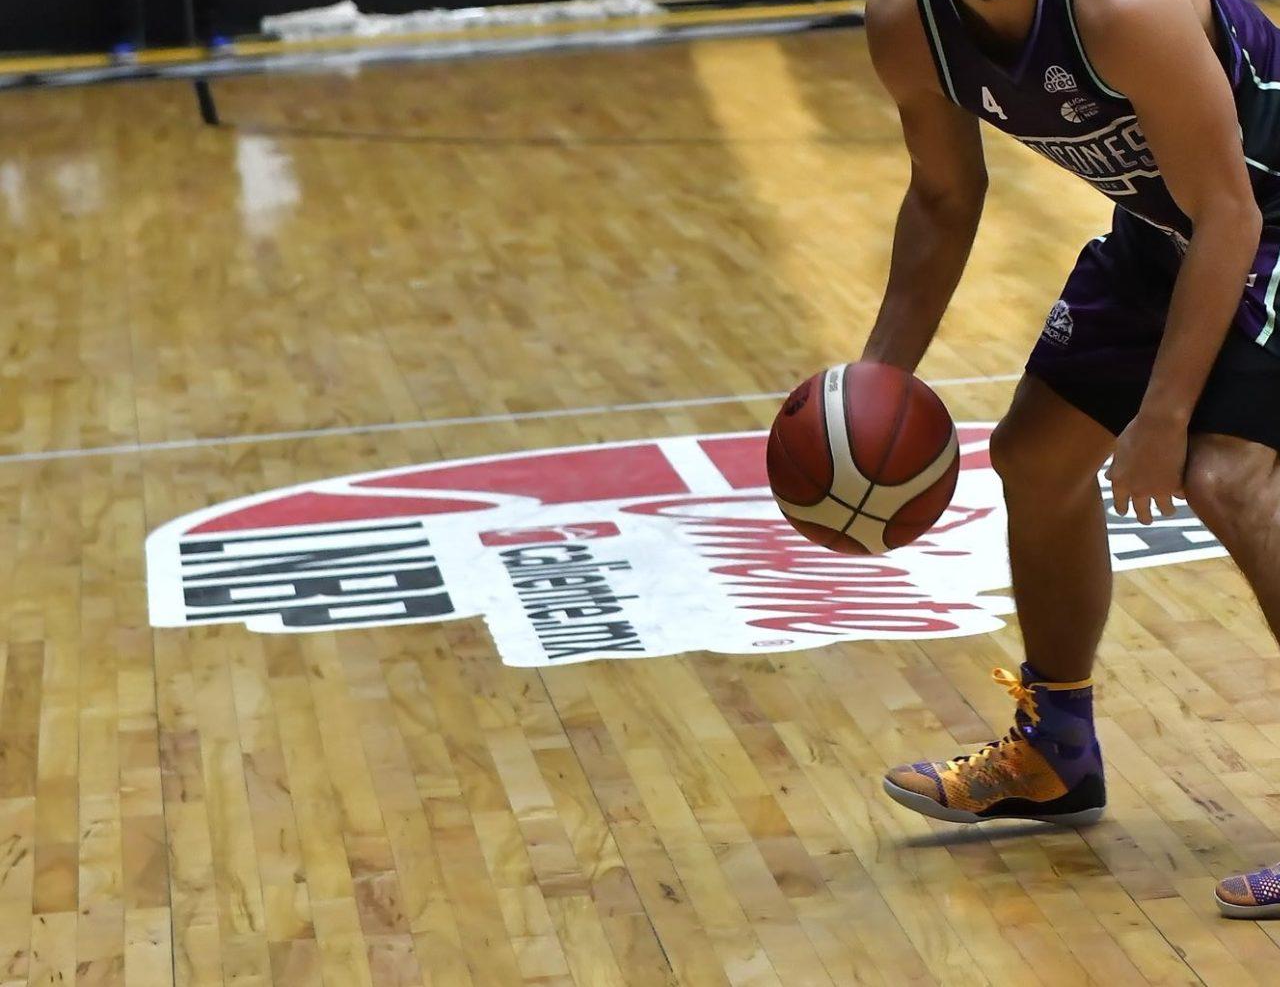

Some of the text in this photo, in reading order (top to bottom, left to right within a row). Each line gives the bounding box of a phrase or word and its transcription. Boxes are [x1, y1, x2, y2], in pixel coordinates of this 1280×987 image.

[981, 86, 1008, 120] 4
[179, 521, 455, 627] LNBP
[499, 544, 646, 660] caliente.mx
